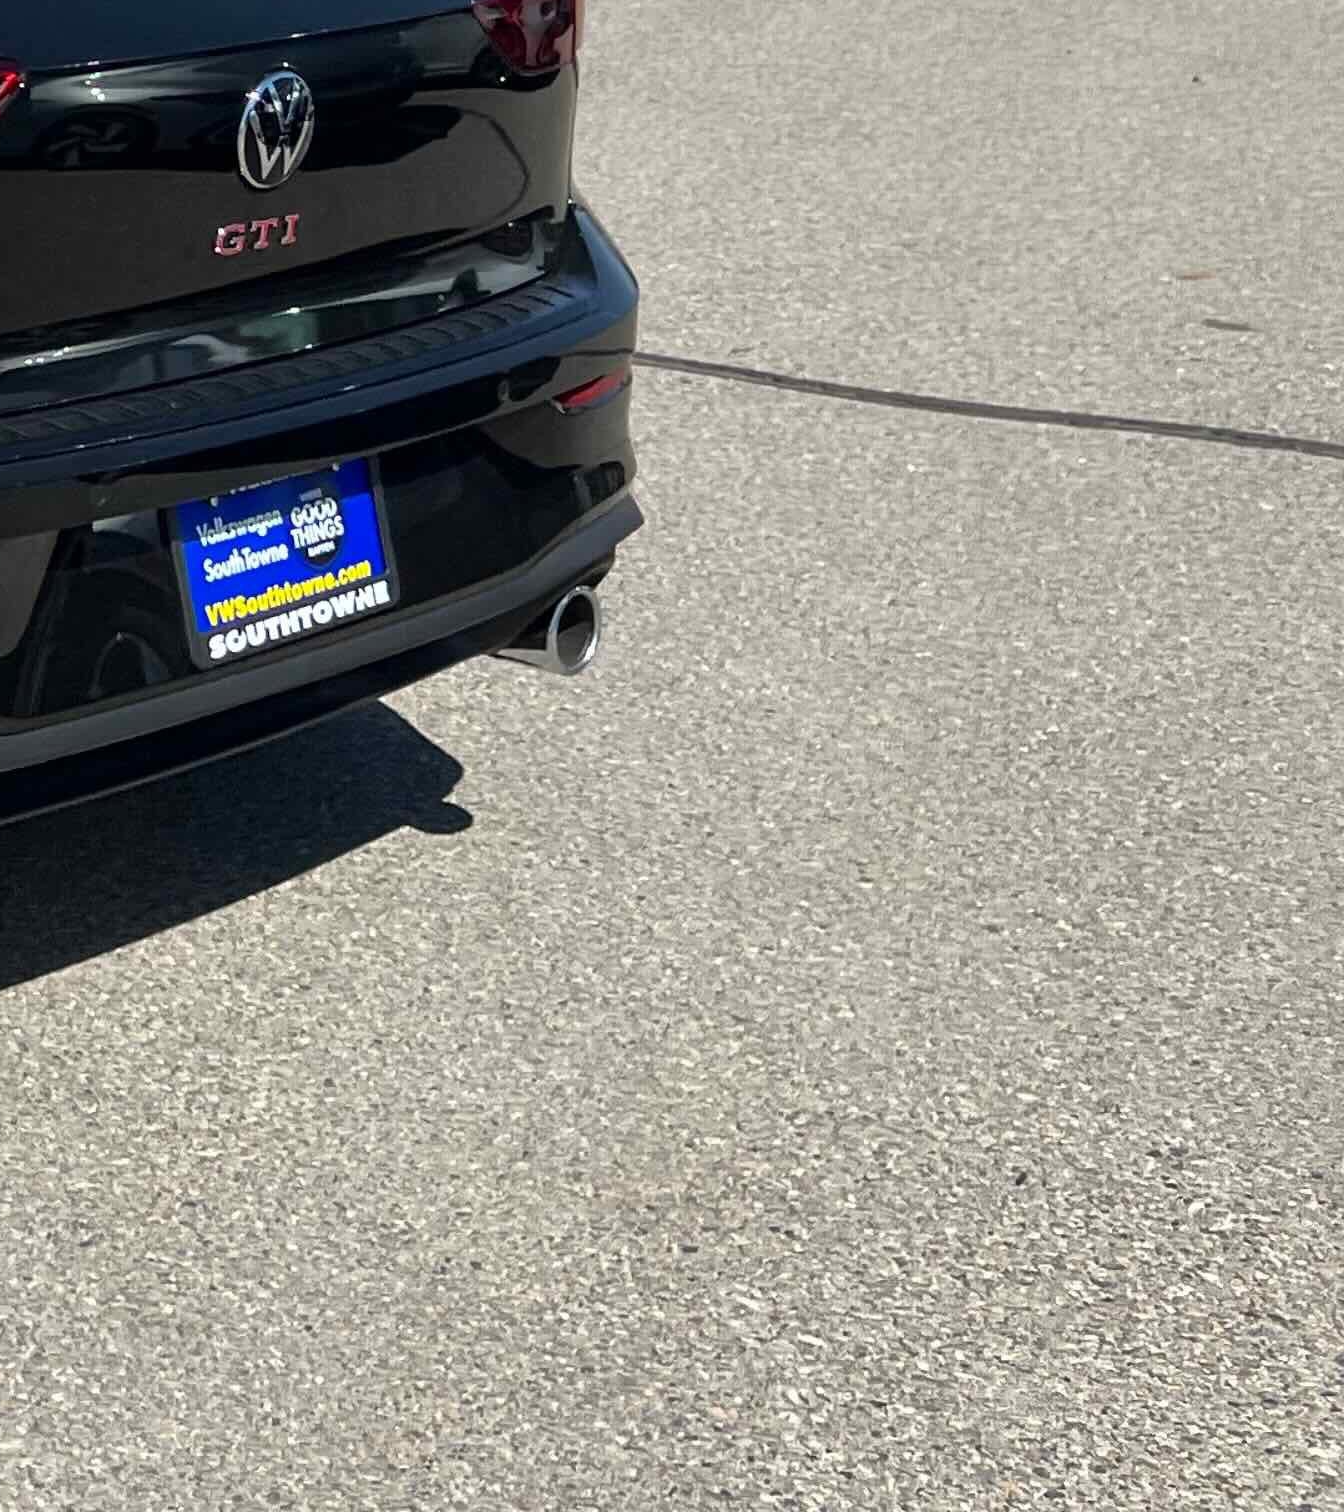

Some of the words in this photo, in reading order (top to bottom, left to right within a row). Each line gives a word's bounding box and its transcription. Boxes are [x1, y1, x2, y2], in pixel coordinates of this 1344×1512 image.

[214, 213, 300, 256] GTI
[196, 509, 284, 546] Volkswagen
[290, 496, 338, 527] GOOD
[290, 515, 345, 549] THINGS
[204, 559, 372, 626] VWSouthtowne.com
[208, 579, 391, 659] SOUTHTOWNE
